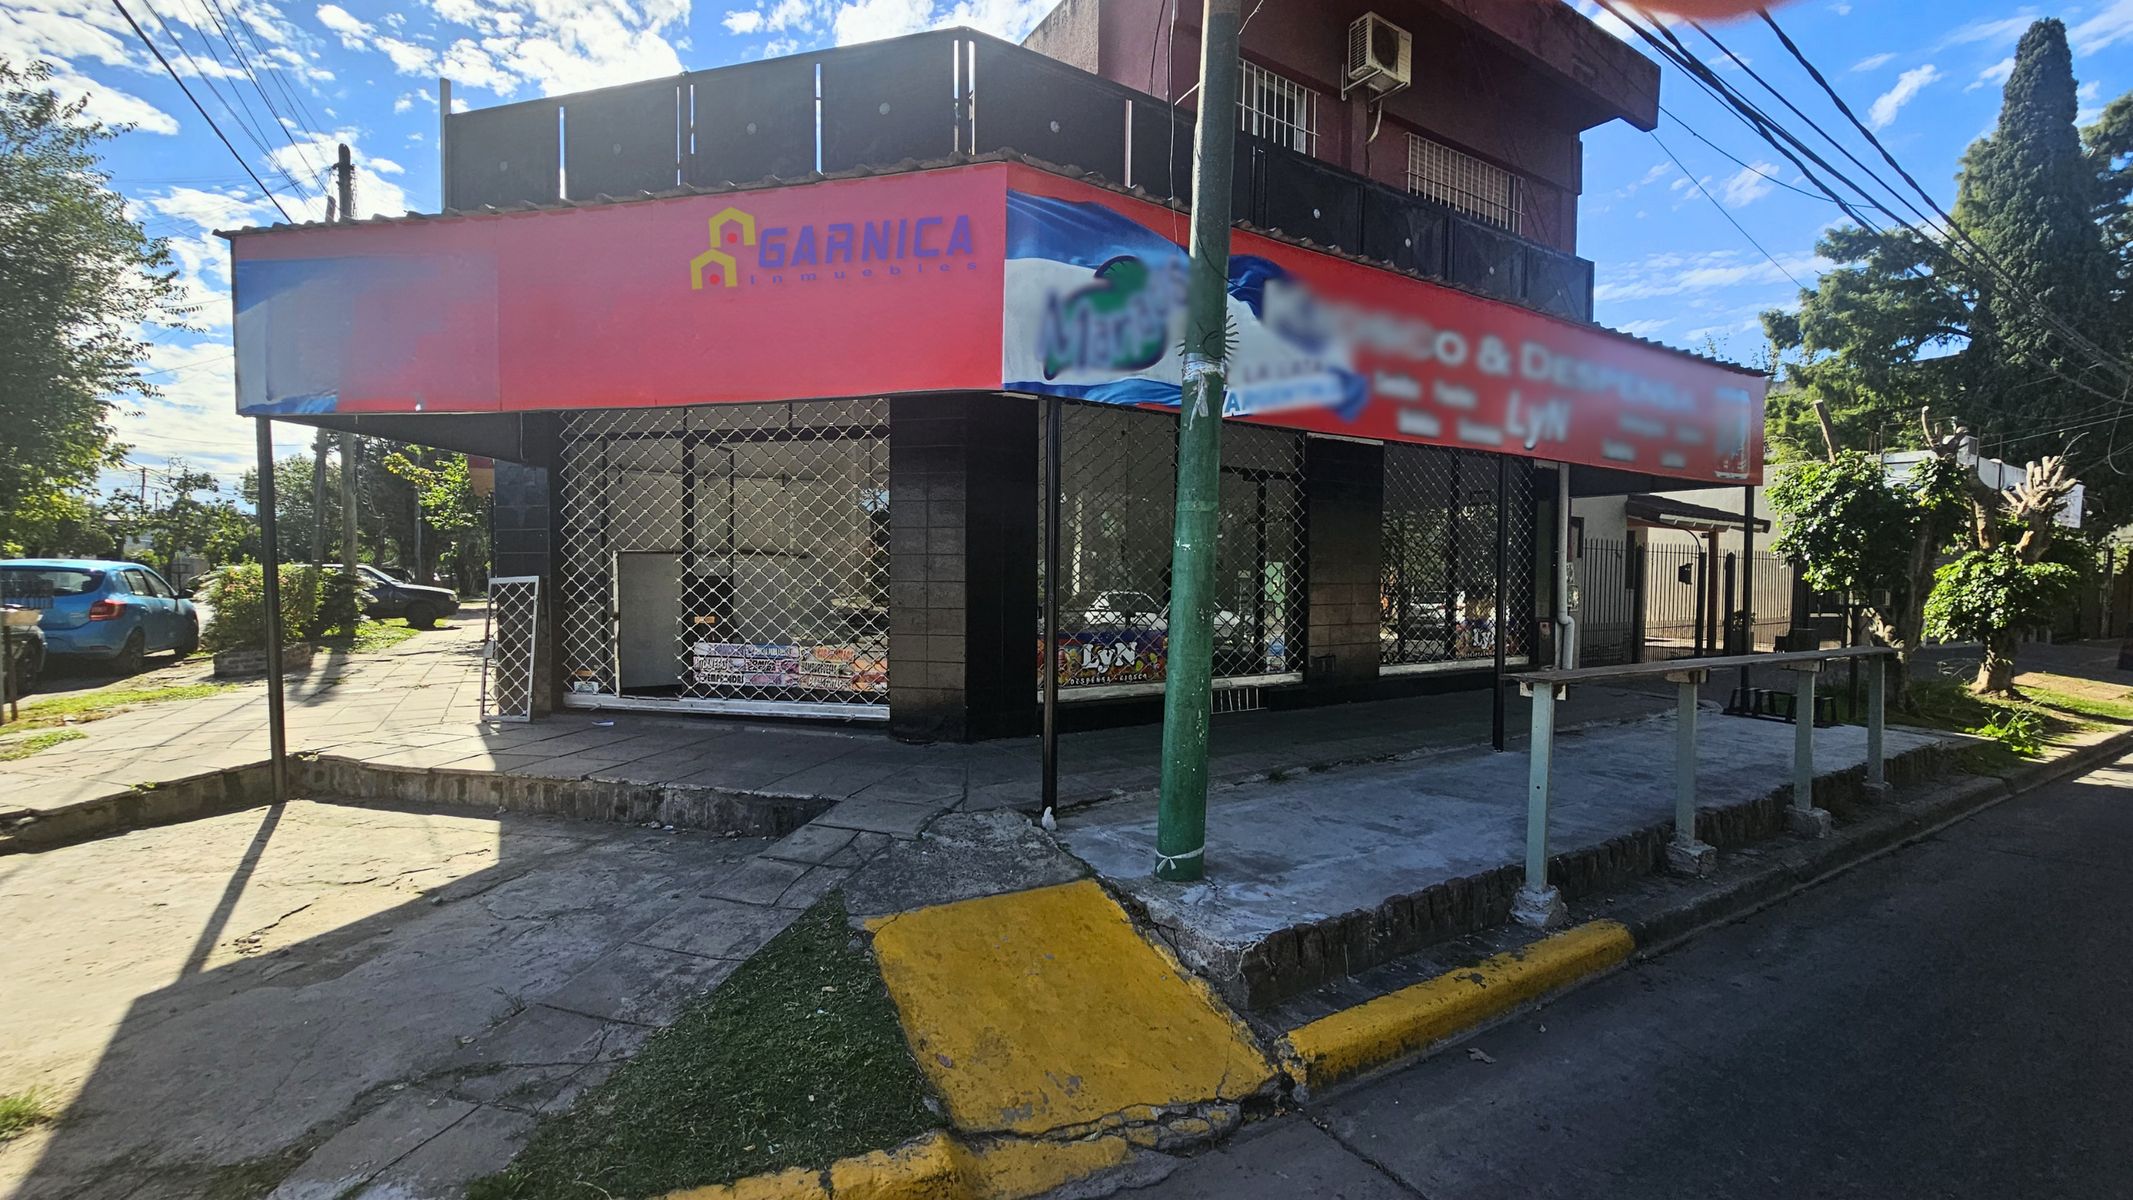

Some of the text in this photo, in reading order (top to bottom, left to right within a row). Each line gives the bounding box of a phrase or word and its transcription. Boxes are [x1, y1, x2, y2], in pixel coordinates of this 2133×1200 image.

[757, 214, 974, 269] GARNICA
[1505, 388, 1571, 450] LyN
[1081, 641, 1138, 674] LyN
